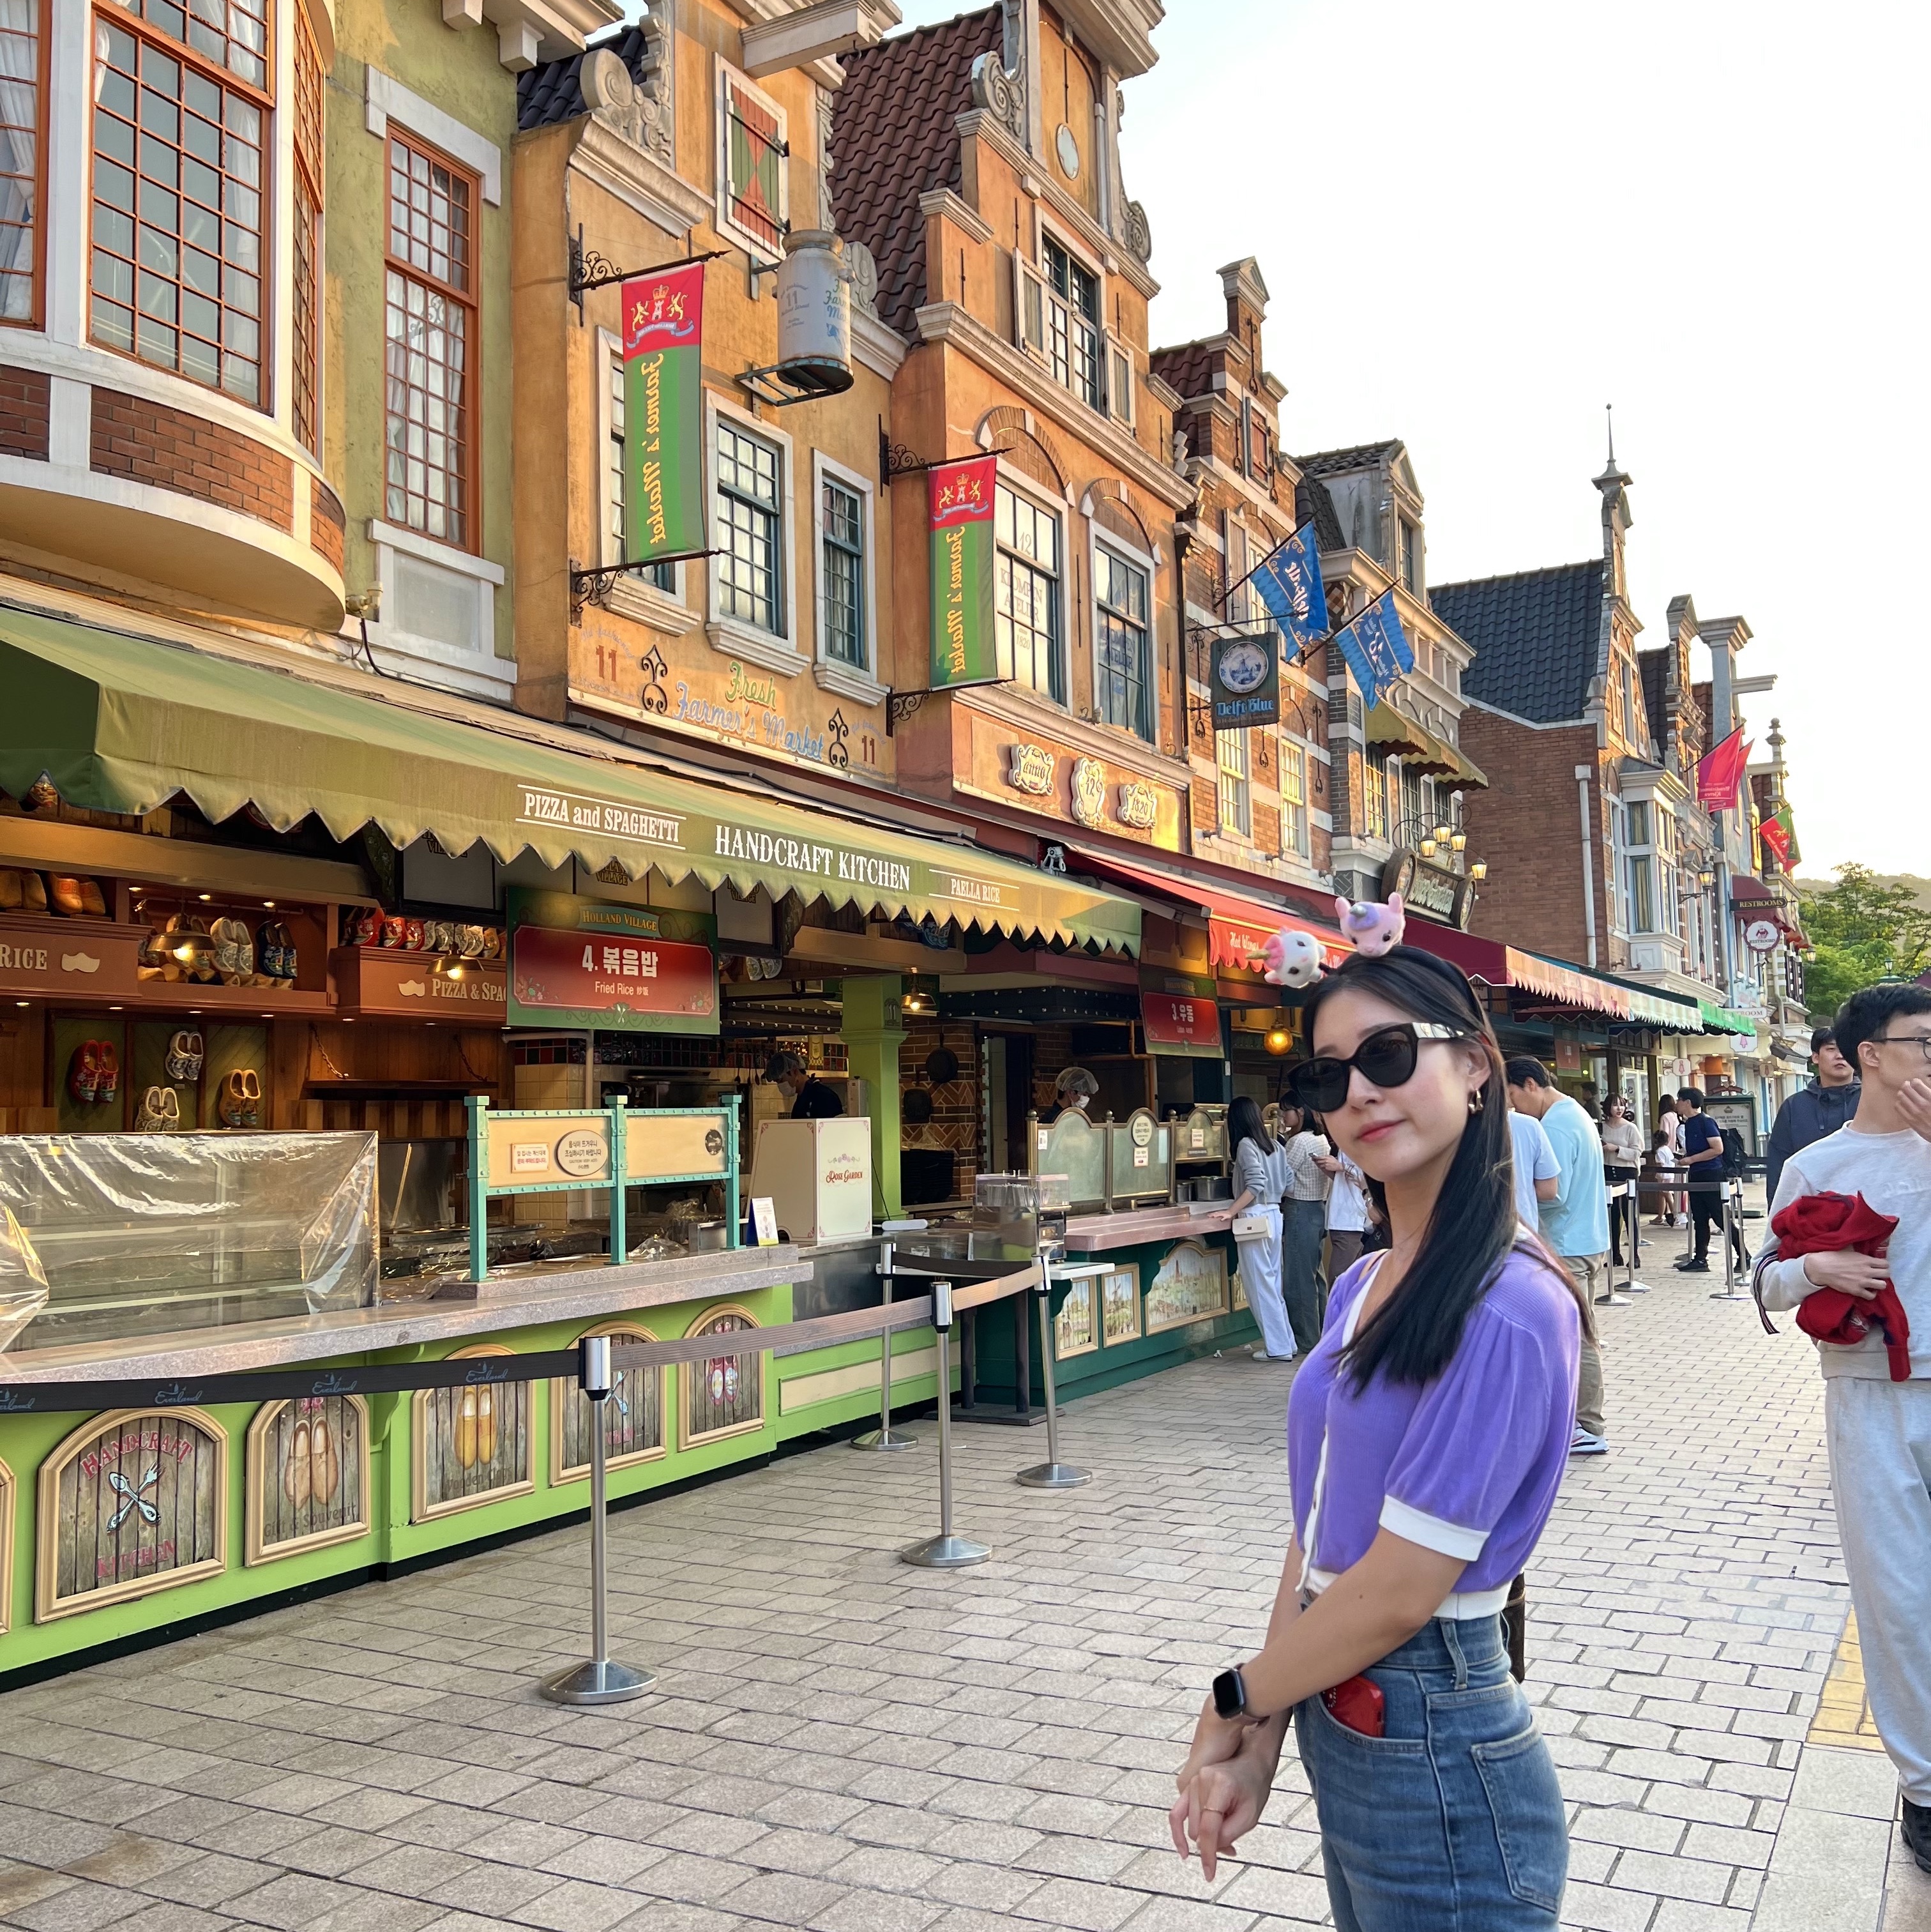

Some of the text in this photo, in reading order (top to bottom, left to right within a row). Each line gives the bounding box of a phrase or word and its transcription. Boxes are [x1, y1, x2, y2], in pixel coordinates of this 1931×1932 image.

[1019, 531, 1032, 556] 12
[1000, 568, 1042, 604] KLOMPN
[1004, 592, 1040, 623] AELIR
[1017, 635, 1031, 650] 1820
[596, 644, 617, 681] 11
[726, 661, 776, 710] Fresh
[1215, 697, 1274, 718] Delft Blue
[673, 680, 757, 740] Farmer's
[762, 711, 824, 761] Market
[861, 734, 875, 765] 11
[1023, 762, 1045, 780] anno
[1086, 775, 1096, 797] 12
[524, 793, 679, 842] PIZZA and SPAGHETTI
[1132, 796, 1149, 816] 1820
[715, 825, 911, 891] HANDCRAFT KITCHEN
[596, 871, 628, 886] VILLAGE
[951, 878, 1001, 903] PAELLA RICE
[1739, 898, 1783, 908] RESTROOMS
[582, 910, 657, 931] HOLLAND VILLAGE
[1230, 932, 1241, 948] Hot
[0, 943, 47, 971] RICE
[582, 945, 659, 978] 4. 볶음밥
[431, 978, 468, 999] PIZZA
[471, 984, 480, 1000] &
[595, 981, 615, 994] Fried
[617, 983, 634, 996] Rice
[466, 1368, 509, 1383] Everland
[155, 1390, 203, 1404] Everland
[312, 1380, 358, 1395] Everland
[80, 1430, 194, 1480] HANDCRAFT
[97, 1537, 176, 1579] KITCHEN
